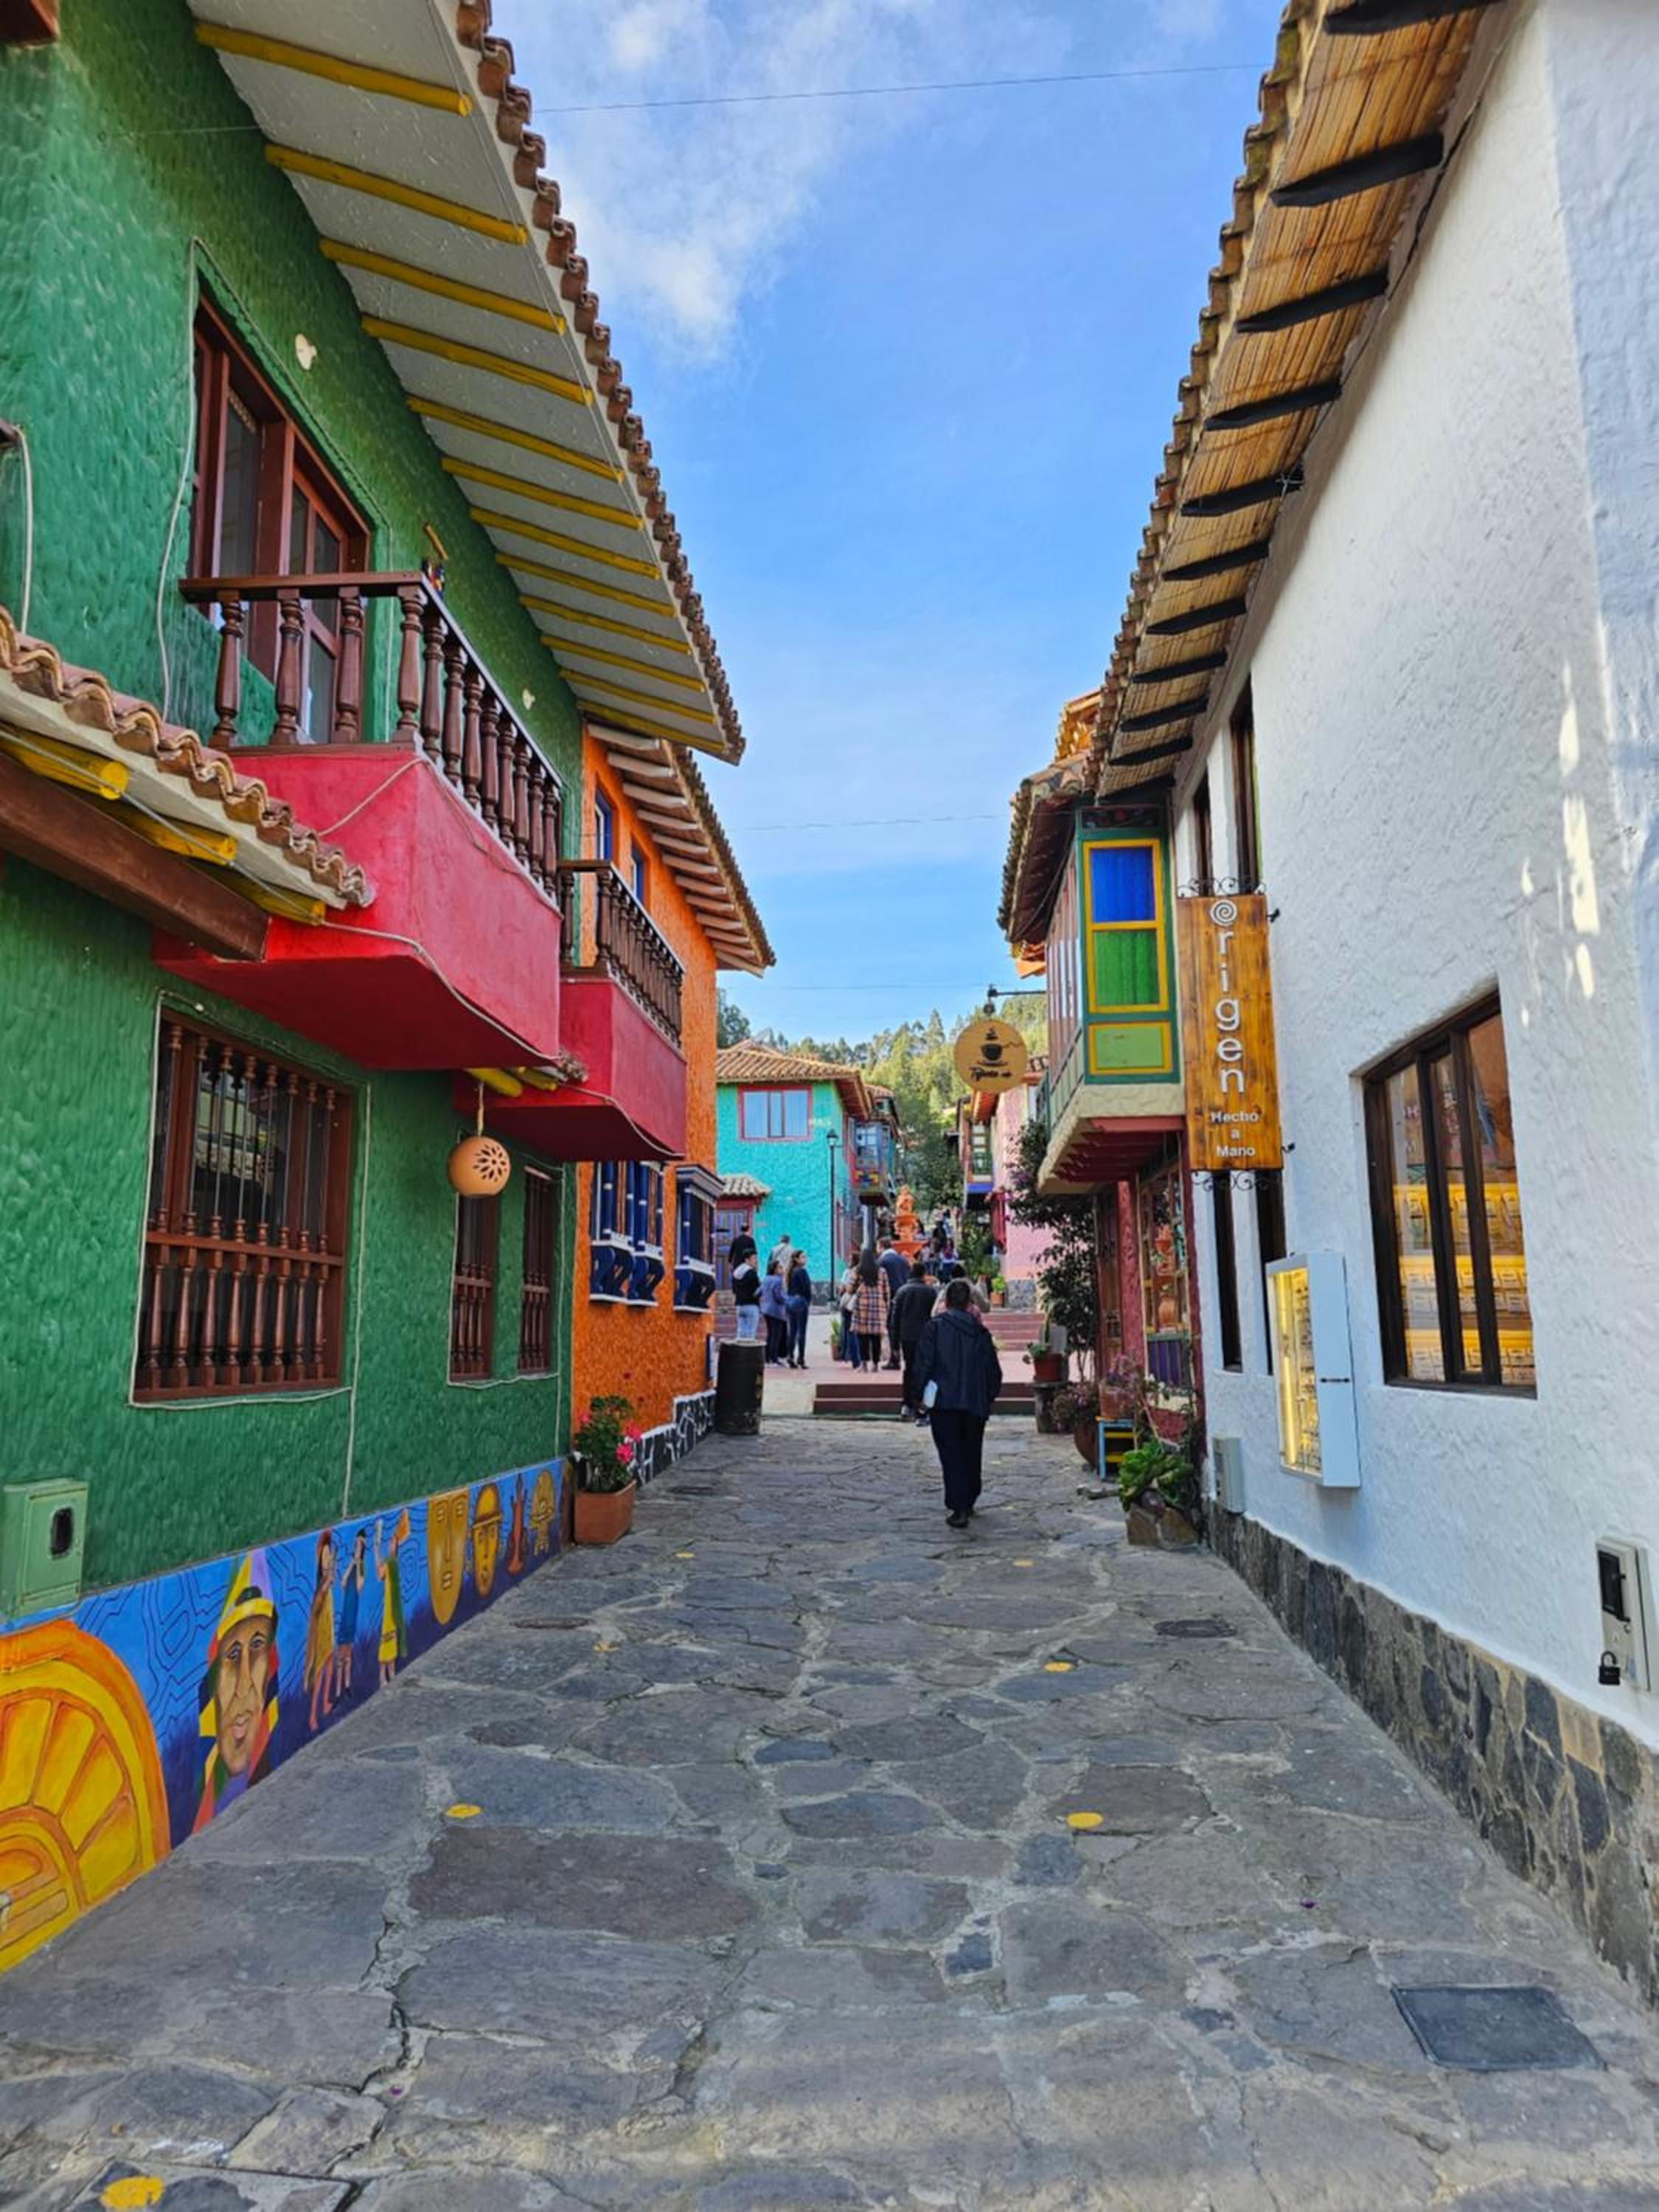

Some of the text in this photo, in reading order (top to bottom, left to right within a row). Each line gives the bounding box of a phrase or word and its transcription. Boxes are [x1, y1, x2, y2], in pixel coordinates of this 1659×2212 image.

[1211, 1110, 1259, 1122] Hecho
[1231, 1129, 1239, 1139] a
[1216, 1144, 1256, 1157] Mano
